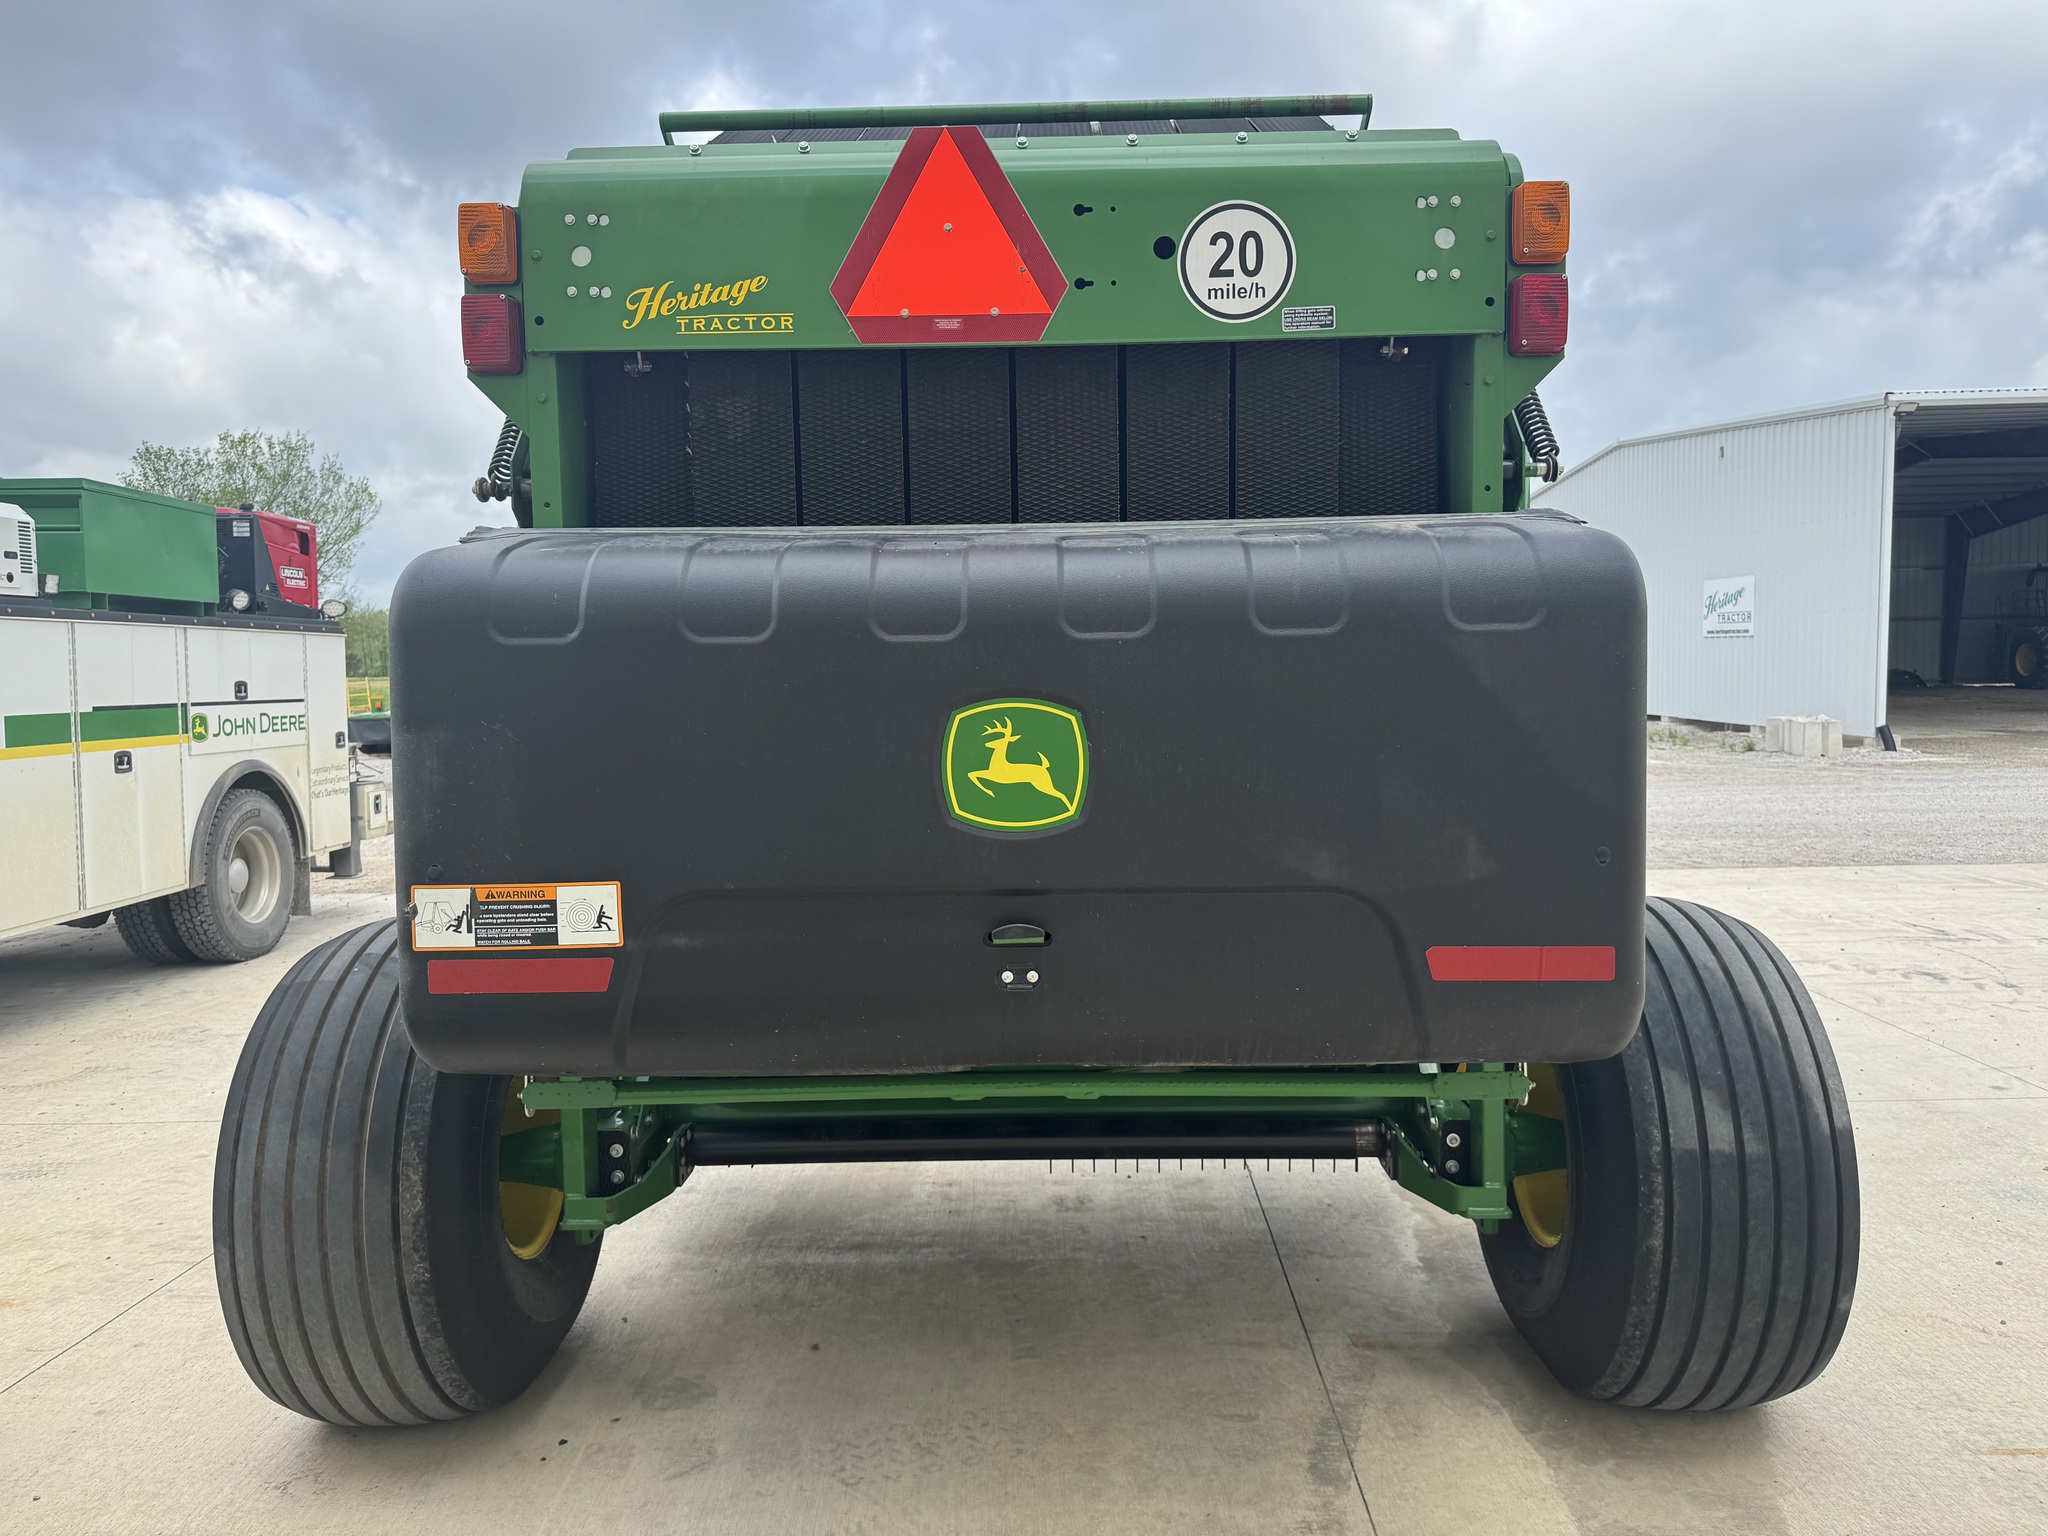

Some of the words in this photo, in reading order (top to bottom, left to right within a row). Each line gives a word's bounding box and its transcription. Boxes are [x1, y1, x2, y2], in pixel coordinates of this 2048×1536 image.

[1208, 230, 1264, 278] 20
[1207, 282, 1266, 300] mile/h
[622, 275, 769, 330] Heritage
[676, 317, 794, 332] TRACTOR
[281, 568, 304, 579] LINCOLN
[1703, 587, 1745, 620] Heritage
[1717, 613, 1752, 622] TRACTOR
[213, 714, 256, 737] JOHN
[259, 712, 306, 734] DEERE
[496, 889, 546, 899] WARNING
